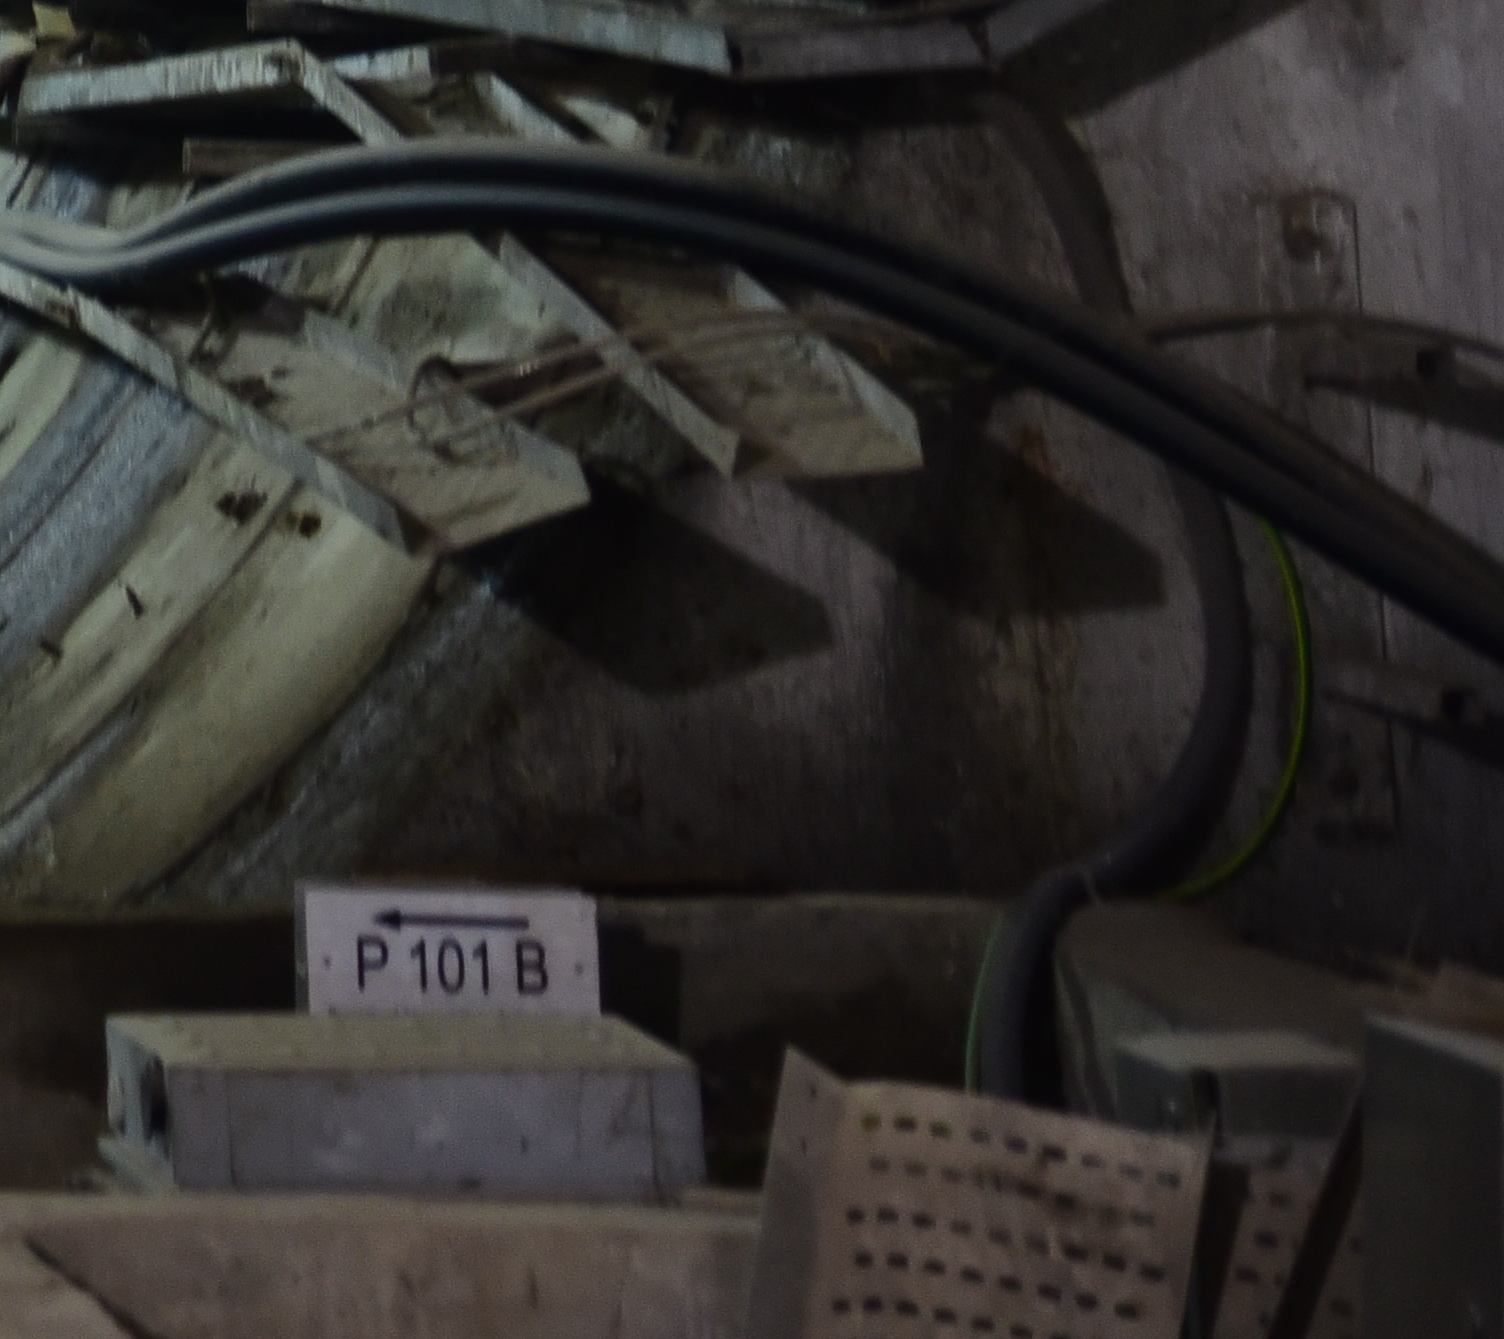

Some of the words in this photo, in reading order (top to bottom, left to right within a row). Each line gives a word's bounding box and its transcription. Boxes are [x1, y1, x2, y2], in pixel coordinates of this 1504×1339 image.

[356, 934, 390, 994] P
[410, 935, 490, 996] 101
[515, 936, 550, 996] B
